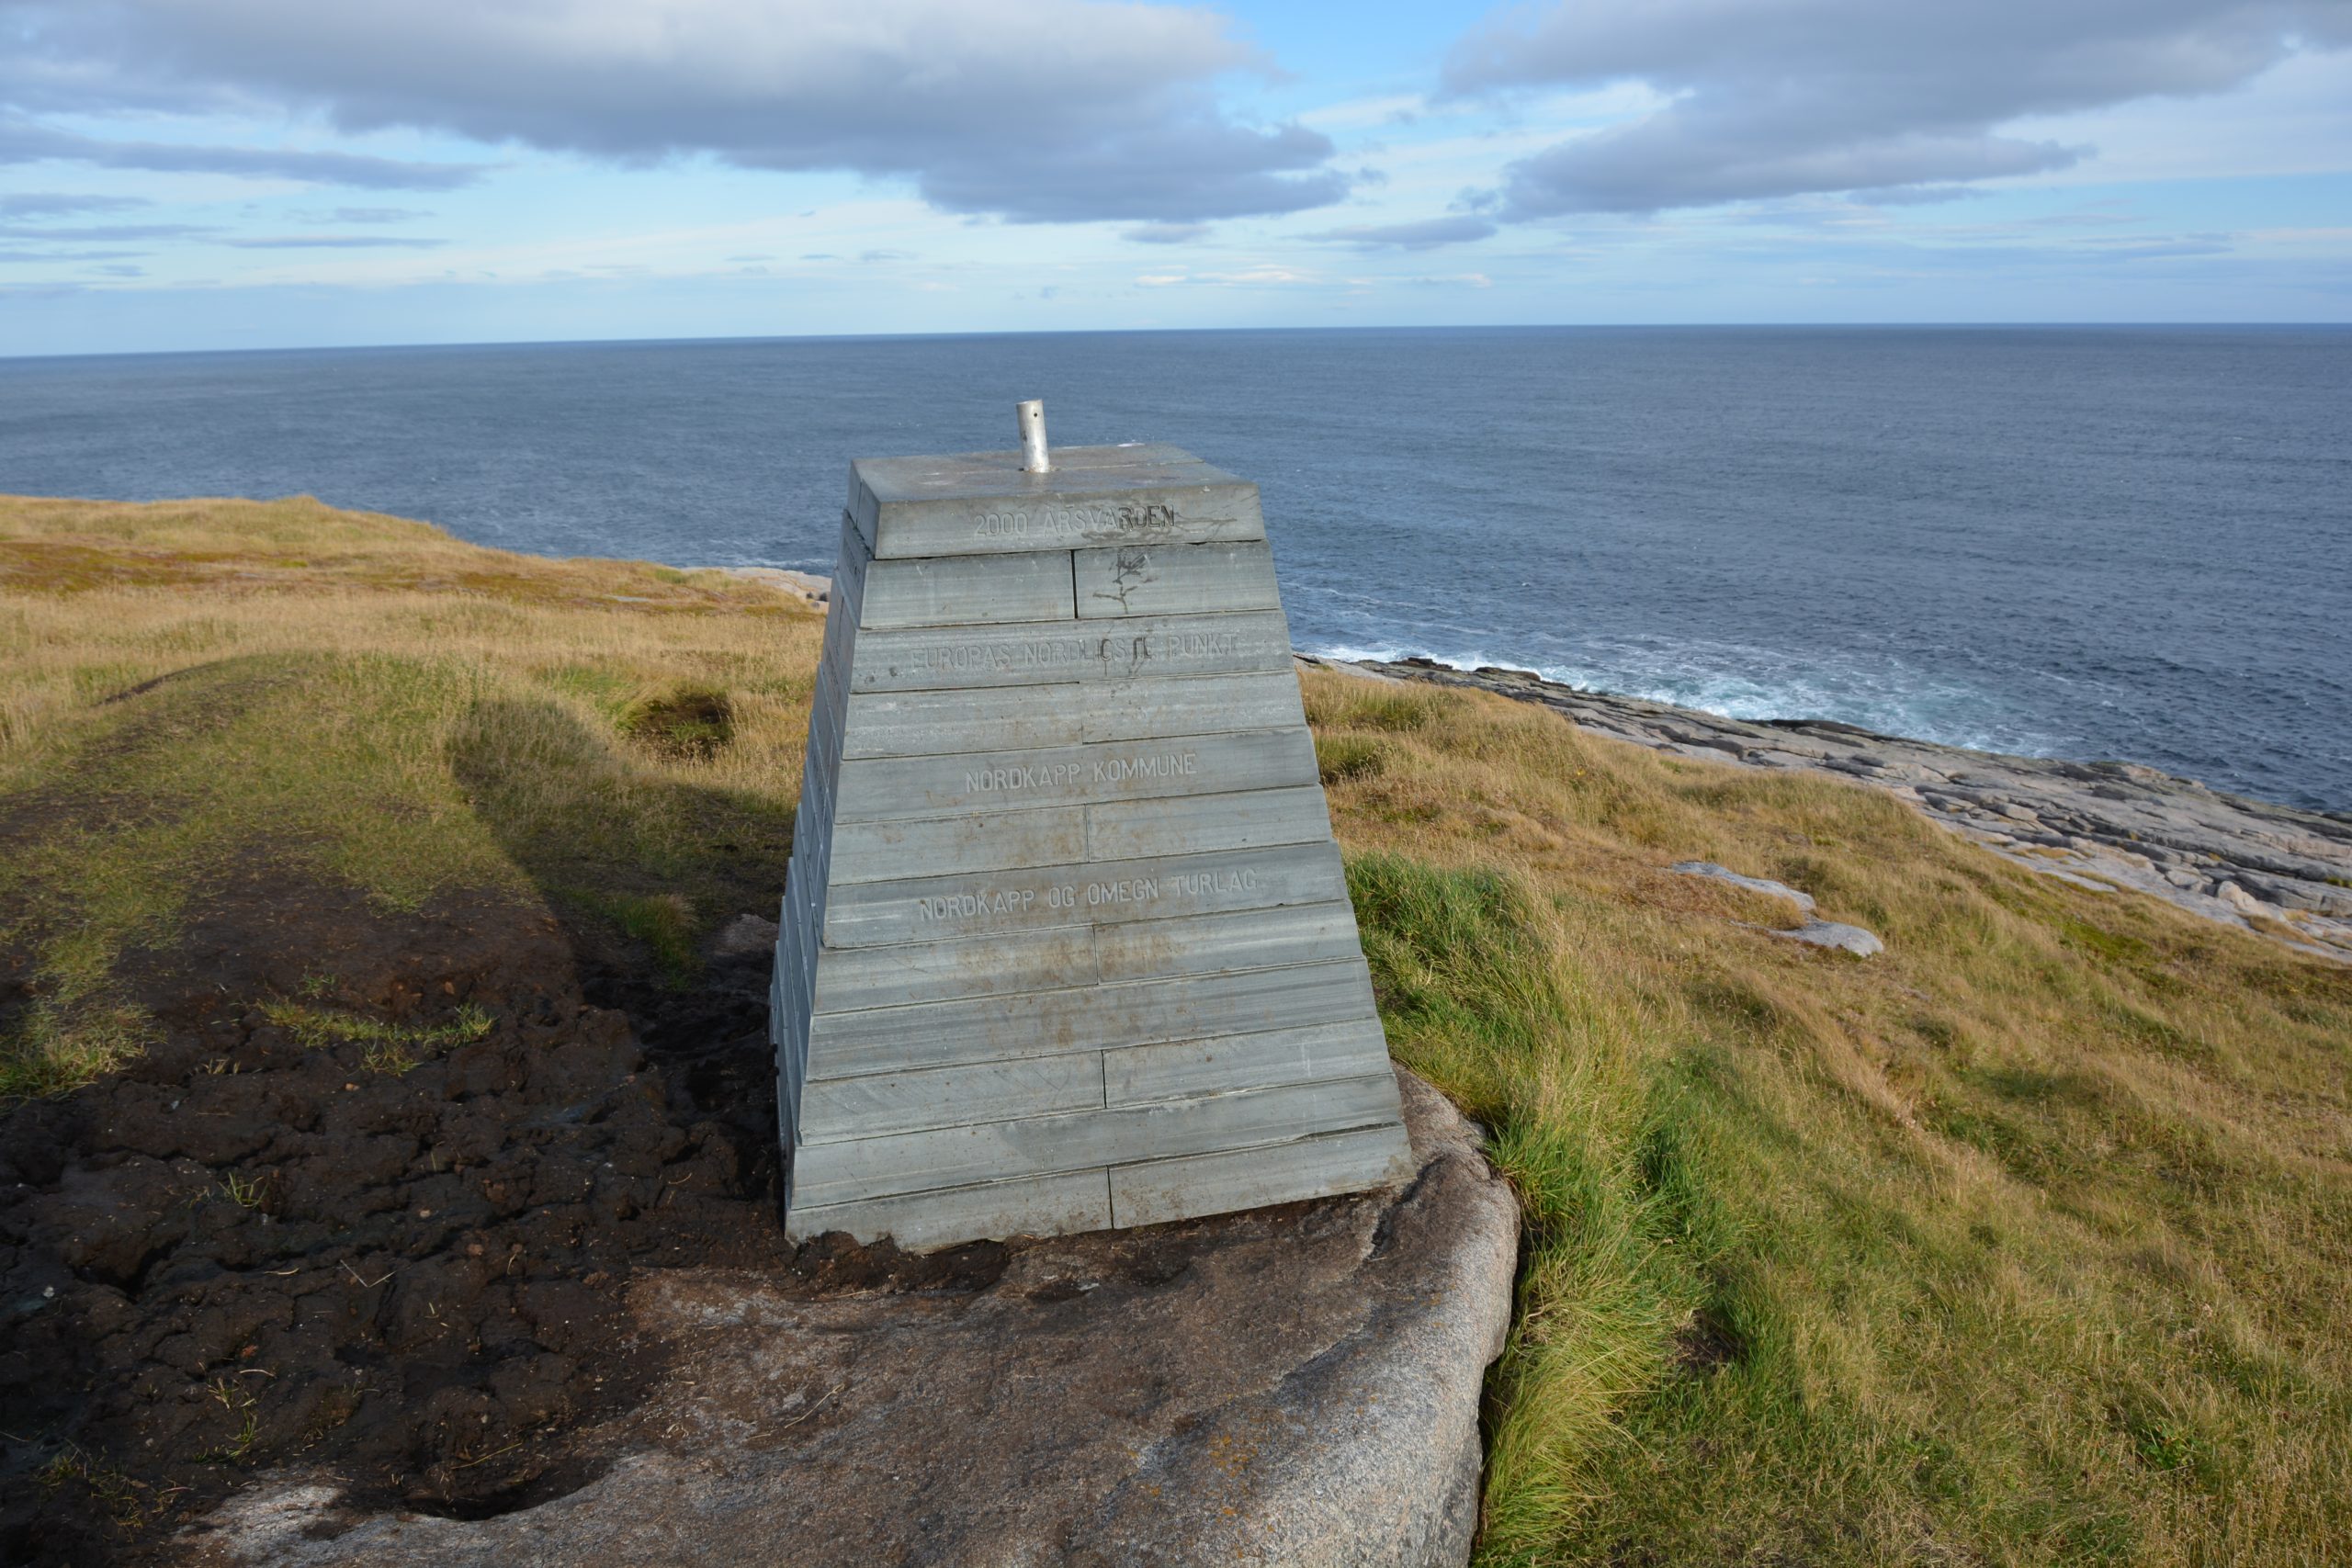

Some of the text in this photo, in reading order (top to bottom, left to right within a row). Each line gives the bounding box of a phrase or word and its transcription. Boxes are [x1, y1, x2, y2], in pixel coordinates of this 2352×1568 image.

[974, 512, 1029, 536] 2000
[910, 633, 1238, 670] EUROPAS NORDLIGSTE PUNKT
[967, 753, 1197, 793] NORDKAPP KOMMUNE
[920, 869, 1258, 921] NORDKAPP OG OMEGN TURLAG
